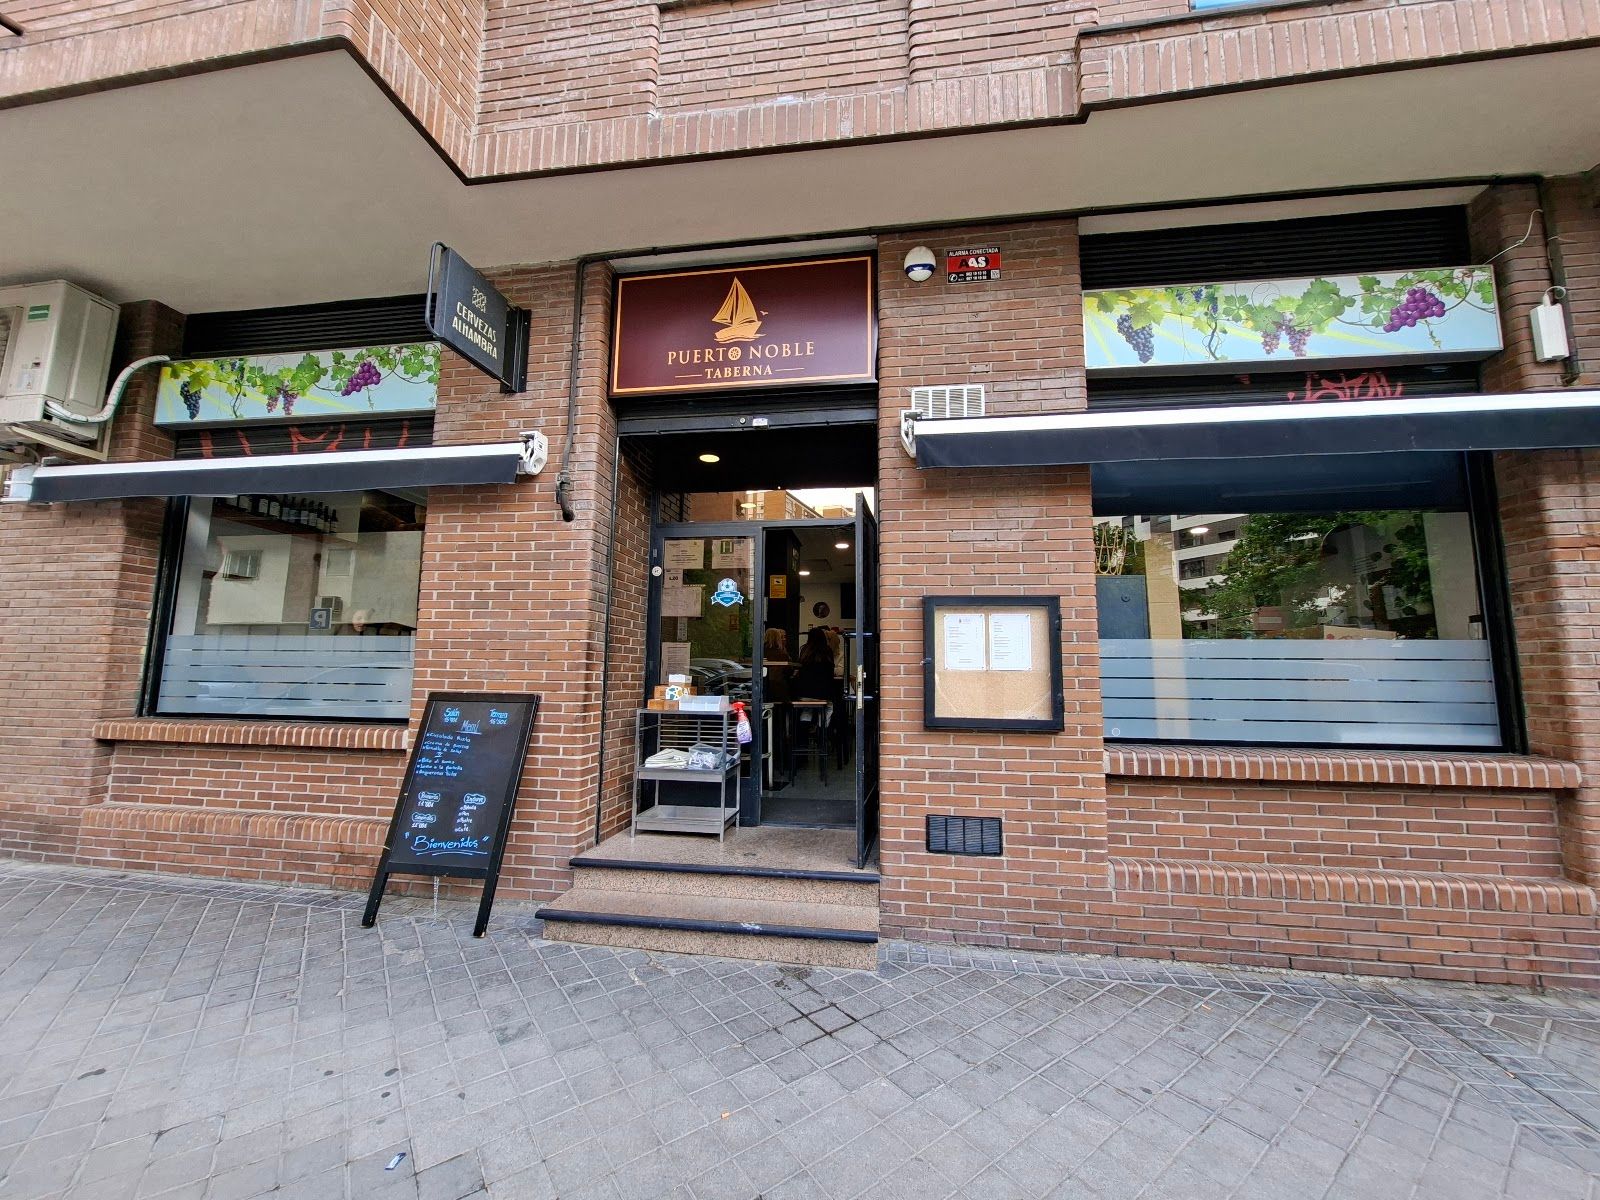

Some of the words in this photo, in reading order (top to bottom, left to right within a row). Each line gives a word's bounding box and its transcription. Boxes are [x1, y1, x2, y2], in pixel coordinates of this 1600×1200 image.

[451, 315, 498, 360] ALHAMBRA
[456, 301, 497, 343] CERVEZAS
[667, 346, 742, 365] PUERTO
[748, 341, 815, 360] NOBLE
[704, 364, 773, 379] TABERNA
